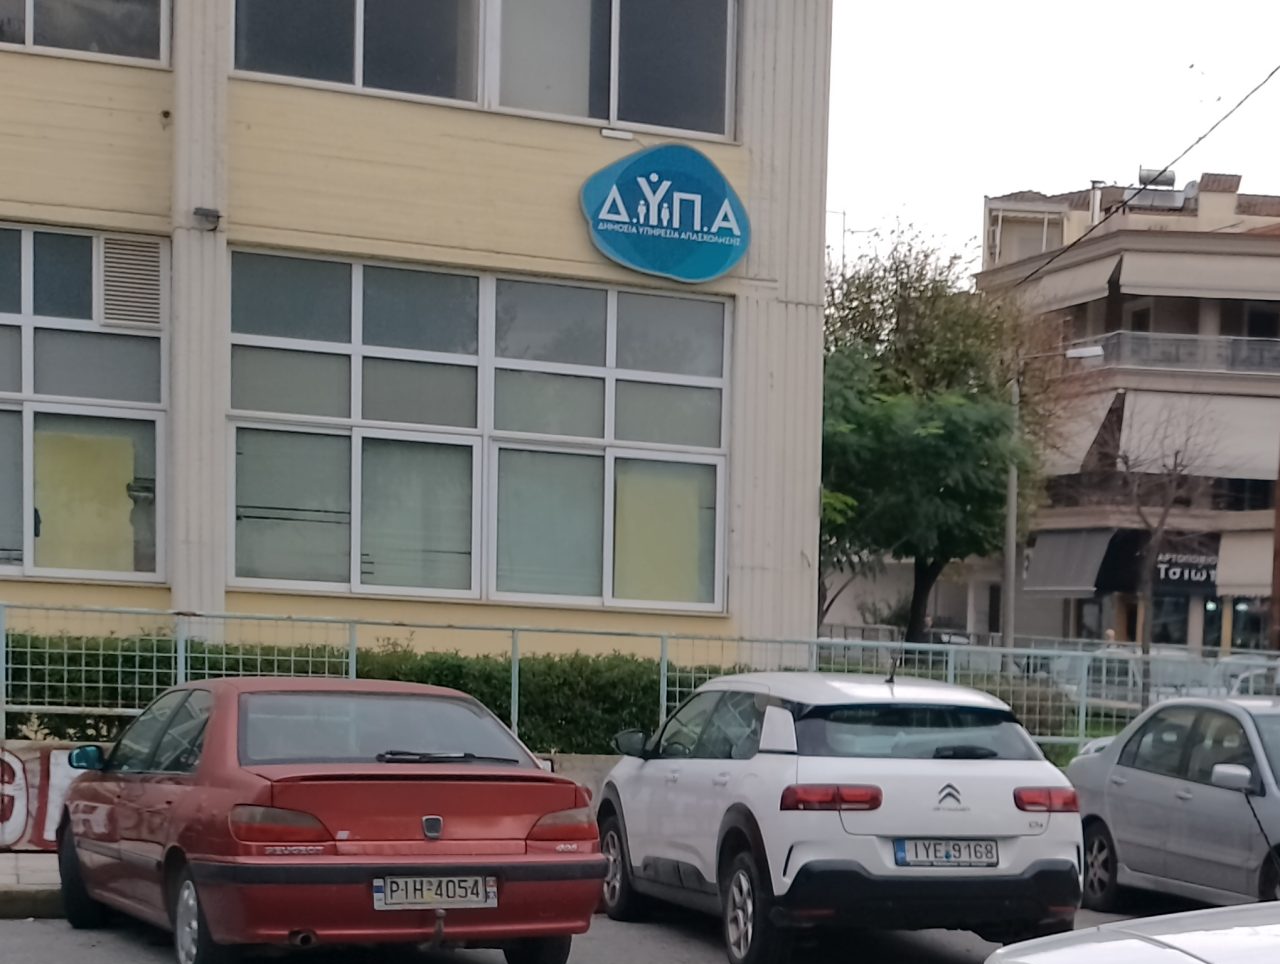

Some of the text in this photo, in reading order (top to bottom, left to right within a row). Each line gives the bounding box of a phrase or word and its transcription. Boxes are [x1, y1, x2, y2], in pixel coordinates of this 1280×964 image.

[597, 221, 741, 246] ΔΗΜΟΣΙΑ ΥΠΗΡΕΣΙΑ ΑΠΑΣΧΟΛΗΣΗΣ
